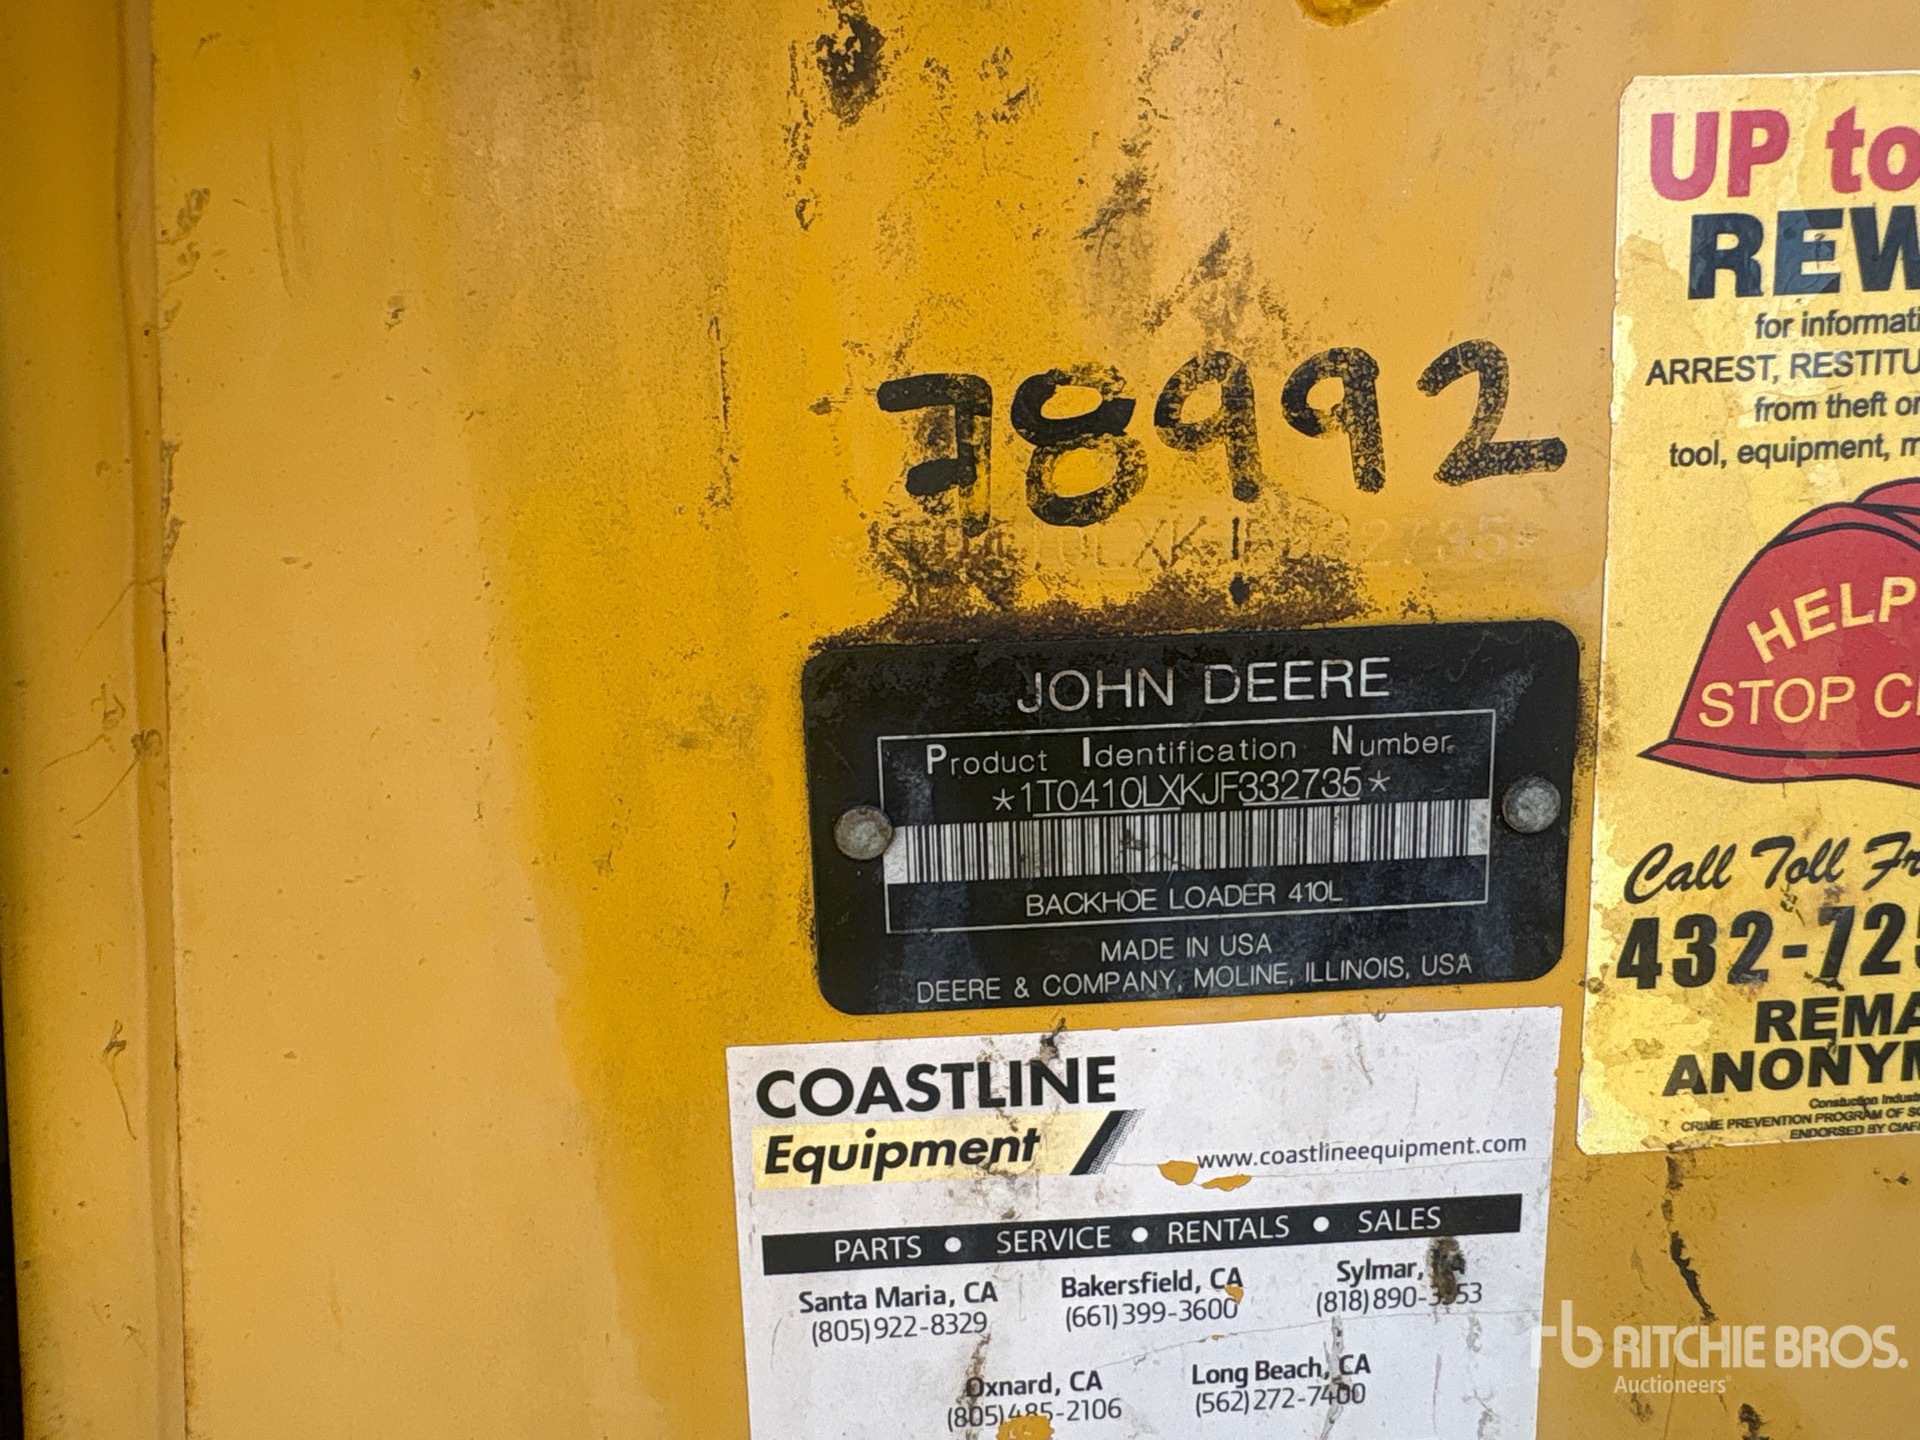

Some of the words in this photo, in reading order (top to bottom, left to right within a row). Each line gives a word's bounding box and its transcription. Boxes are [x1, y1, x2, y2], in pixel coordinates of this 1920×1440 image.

[1650, 109, 1790, 201] UP
[1825, 106, 1920, 193] to
[1755, 313, 1793, 339] for
[1645, 355, 1779, 386] ARREST,
[1789, 347, 1920, 379] RESTITU
[1755, 396, 1817, 422] from
[1826, 391, 1888, 419] theft
[1669, 440, 1727, 468] tool,
[1737, 433, 1891, 469] equipment,
[1746, 576, 1917, 664] HELP
[1017, 667, 1173, 713] JOHN
[1204, 657, 1390, 704] DEERE
[1698, 676, 1856, 728] STOP
[1874, 672, 1920, 718] C
[926, 744, 1048, 775] Product
[1082, 736, 1296, 768] Identification
[1332, 725, 1452, 758] Number
[1623, 842, 1737, 904] Call
[1750, 835, 1850, 889] Toll
[1026, 888, 1158, 917] BACKHOE
[1169, 883, 1276, 910] LOADER
[1288, 880, 1343, 903] 410L
[1101, 937, 1175, 962] MADE
[1186, 936, 1208, 958] IN
[1220, 933, 1272, 957] USA
[1616, 902, 1920, 990] 432-72
[917, 977, 1001, 1004] DEERE
[1014, 976, 1030, 998] &
[1043, 968, 1182, 998] COMPANY,
[1194, 962, 1294, 988] MOLINE,
[1305, 956, 1410, 983] ILLINOIS,
[1421, 953, 1472, 978] USA
[756, 1055, 1116, 1119] COASTLINE
[1681, 1119, 1723, 1132] CRIME
[1727, 1113, 1812, 1130] PREVENTION
[1815, 1109, 1882, 1123] PROGRAM
[1885, 1107, 1904, 1119] OF
[1790, 1124, 1864, 1140] ENDORSED
[1867, 1123, 1887, 1134] BY
[764, 1127, 1041, 1185] Equipment
[1196, 1136, 1527, 1169] www.coastlineequipment.com
[834, 1235, 922, 1263] PARTS
[996, 1226, 1112, 1254] SERVICE
[1168, 1215, 1290, 1244] RENTALS
[1358, 1206, 1441, 1234] SALES
[1061, 1269, 1202, 1299] Bakersfield,
[1210, 1267, 1244, 1290] CA
[1336, 1257, 1424, 1288] Sylmar,
[799, 1290, 867, 1314] Santa
[875, 1284, 955, 1308] Maria,
[963, 1281, 998, 1303] CA
[965, 1371, 1061, 1398] Oxnard,
[1069, 1370, 1103, 1392] CA
[1191, 1365, 1248, 1388] Long
[1255, 1356, 1330, 1381] Beach,
[1338, 1353, 1371, 1376] CA
